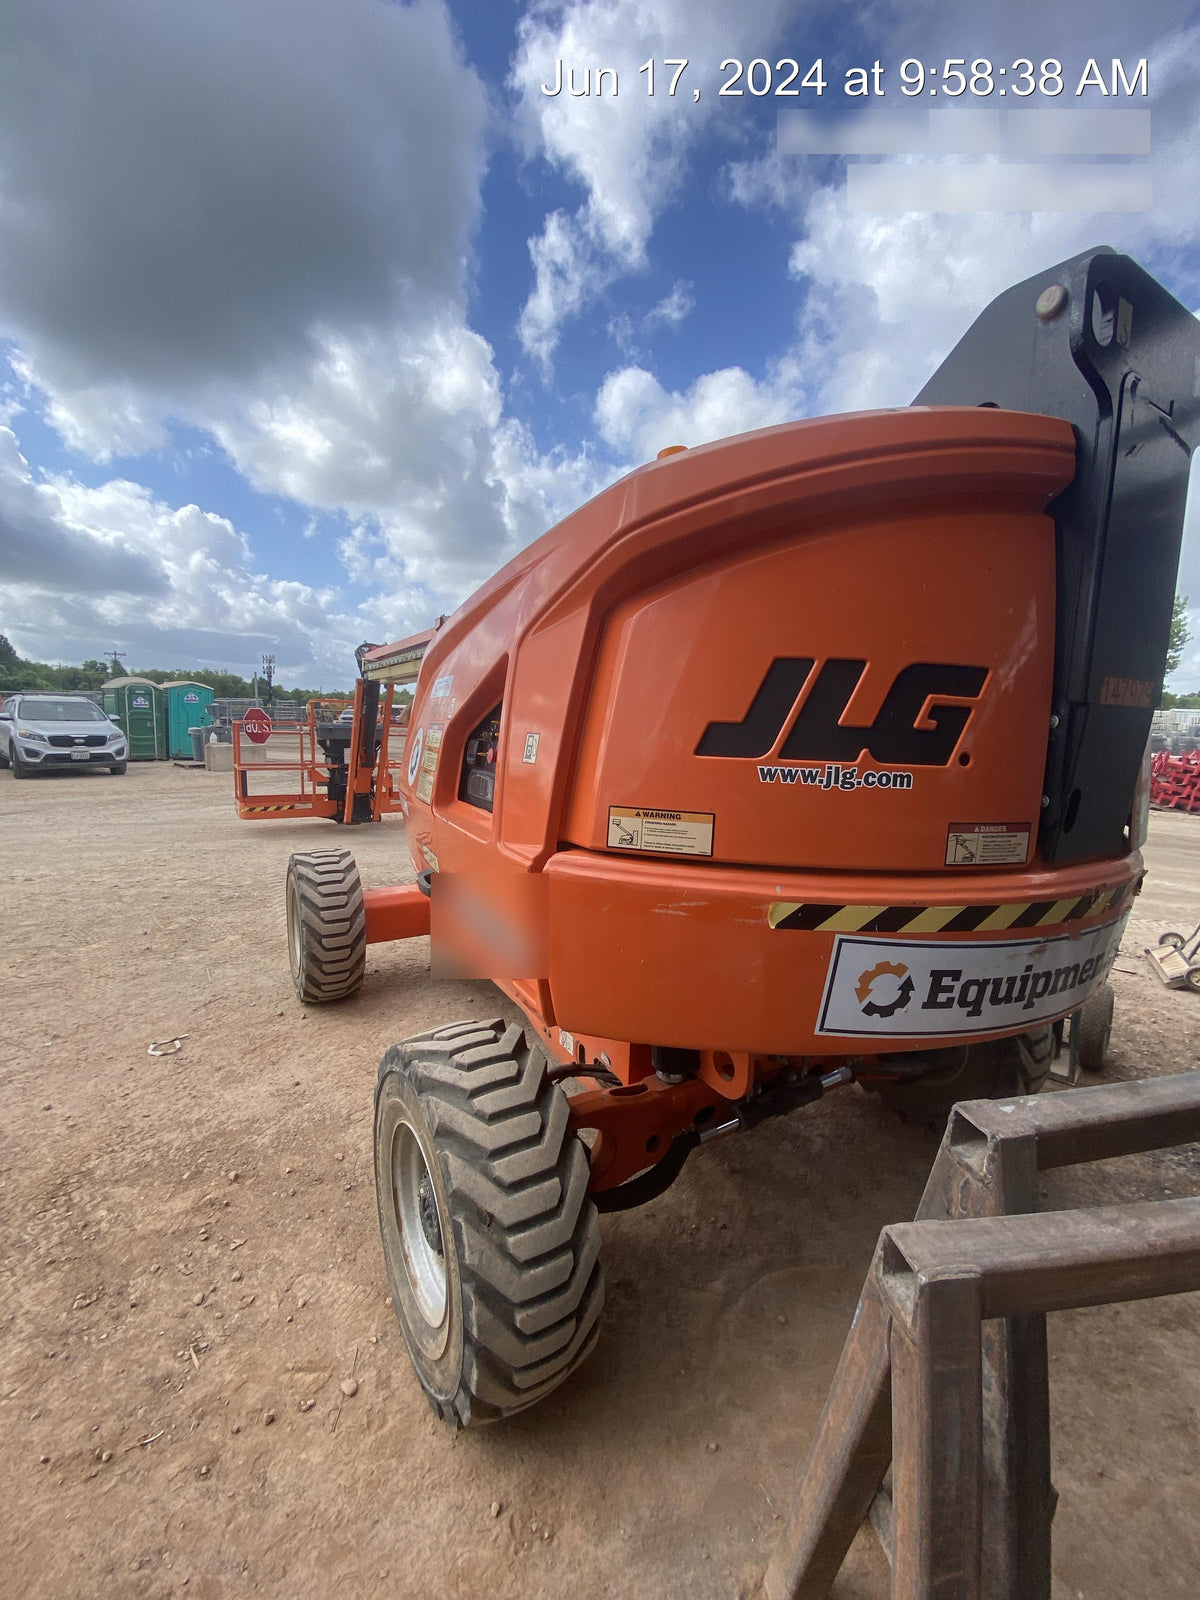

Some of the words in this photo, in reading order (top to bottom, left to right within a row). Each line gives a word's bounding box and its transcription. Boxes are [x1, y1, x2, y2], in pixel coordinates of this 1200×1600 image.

[695, 656, 990, 766] JLG
[245, 719, 270, 733] SOP
[757, 765, 912, 790] www.jlg.com
[642, 811, 681, 820] WARNING
[921, 953, 1106, 1017] Equipmen
